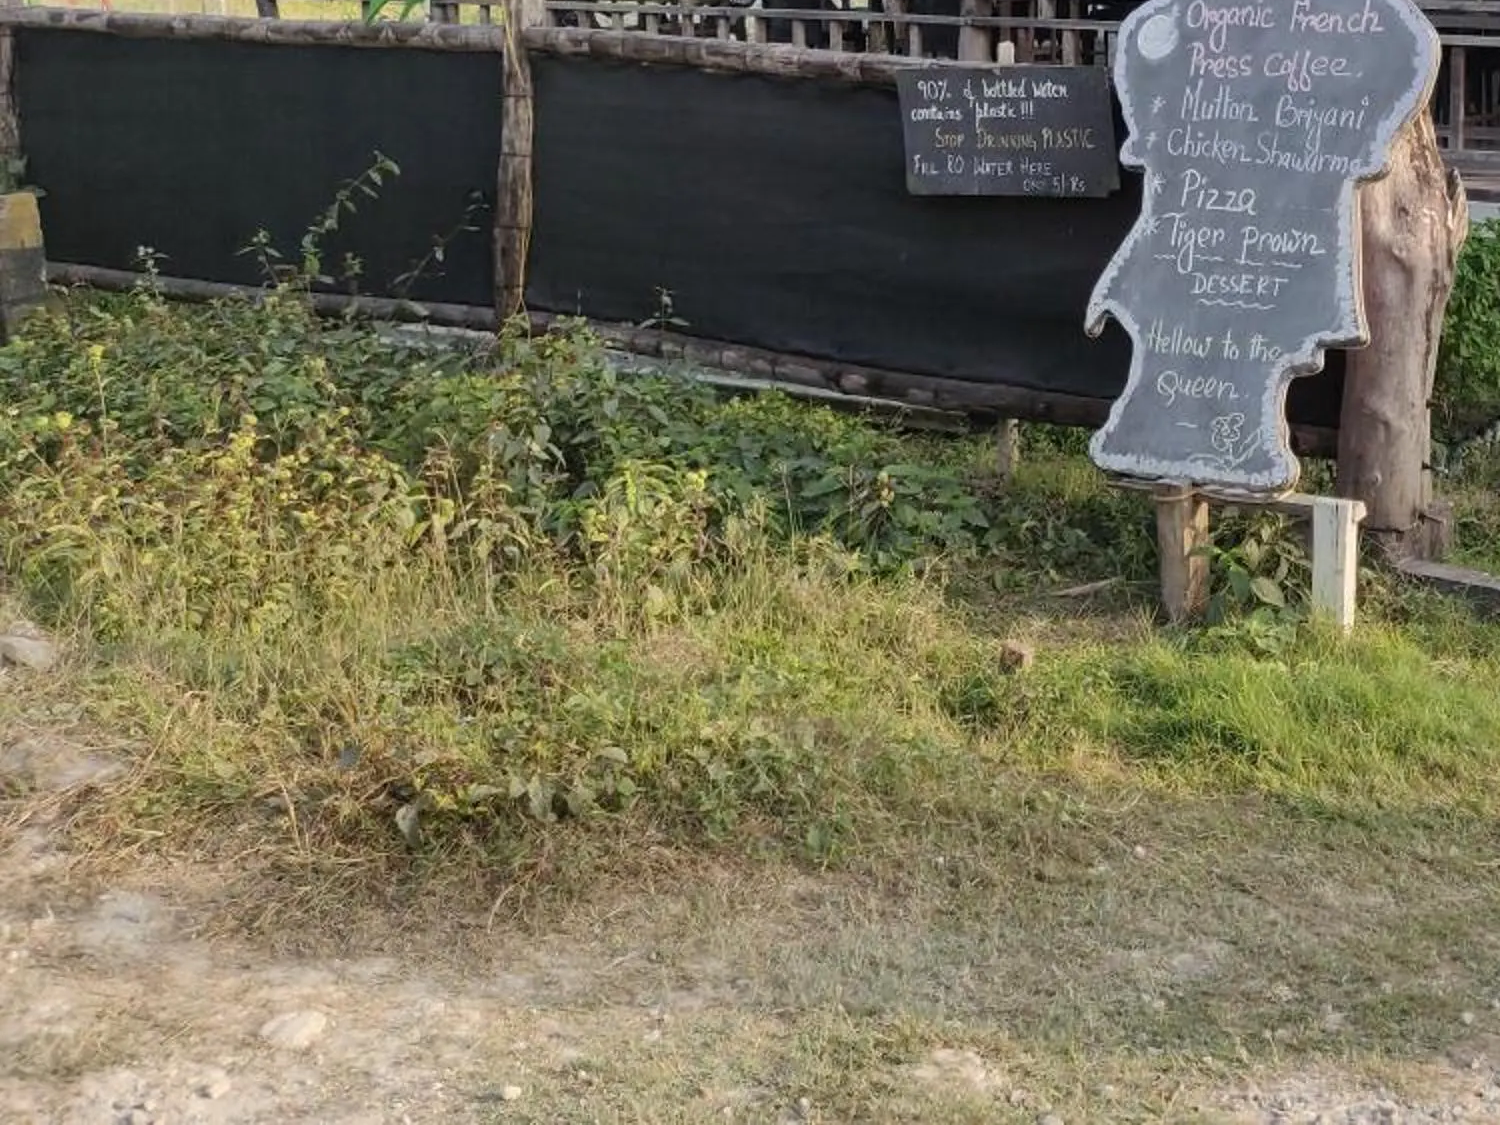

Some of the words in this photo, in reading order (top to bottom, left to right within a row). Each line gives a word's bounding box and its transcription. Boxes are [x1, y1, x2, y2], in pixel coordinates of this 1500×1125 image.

[1186, 41, 1252, 78] Press
[1180, 78, 1259, 122] Mutton
[1167, 125, 1252, 164] Chicken
[1180, 168, 1257, 216] Pizza
[1161, 212, 1226, 274] Tiger
[1190, 273, 1290, 297] DESSERT
[1221, 328, 1240, 360] to
[1249, 333, 1281, 362] the
